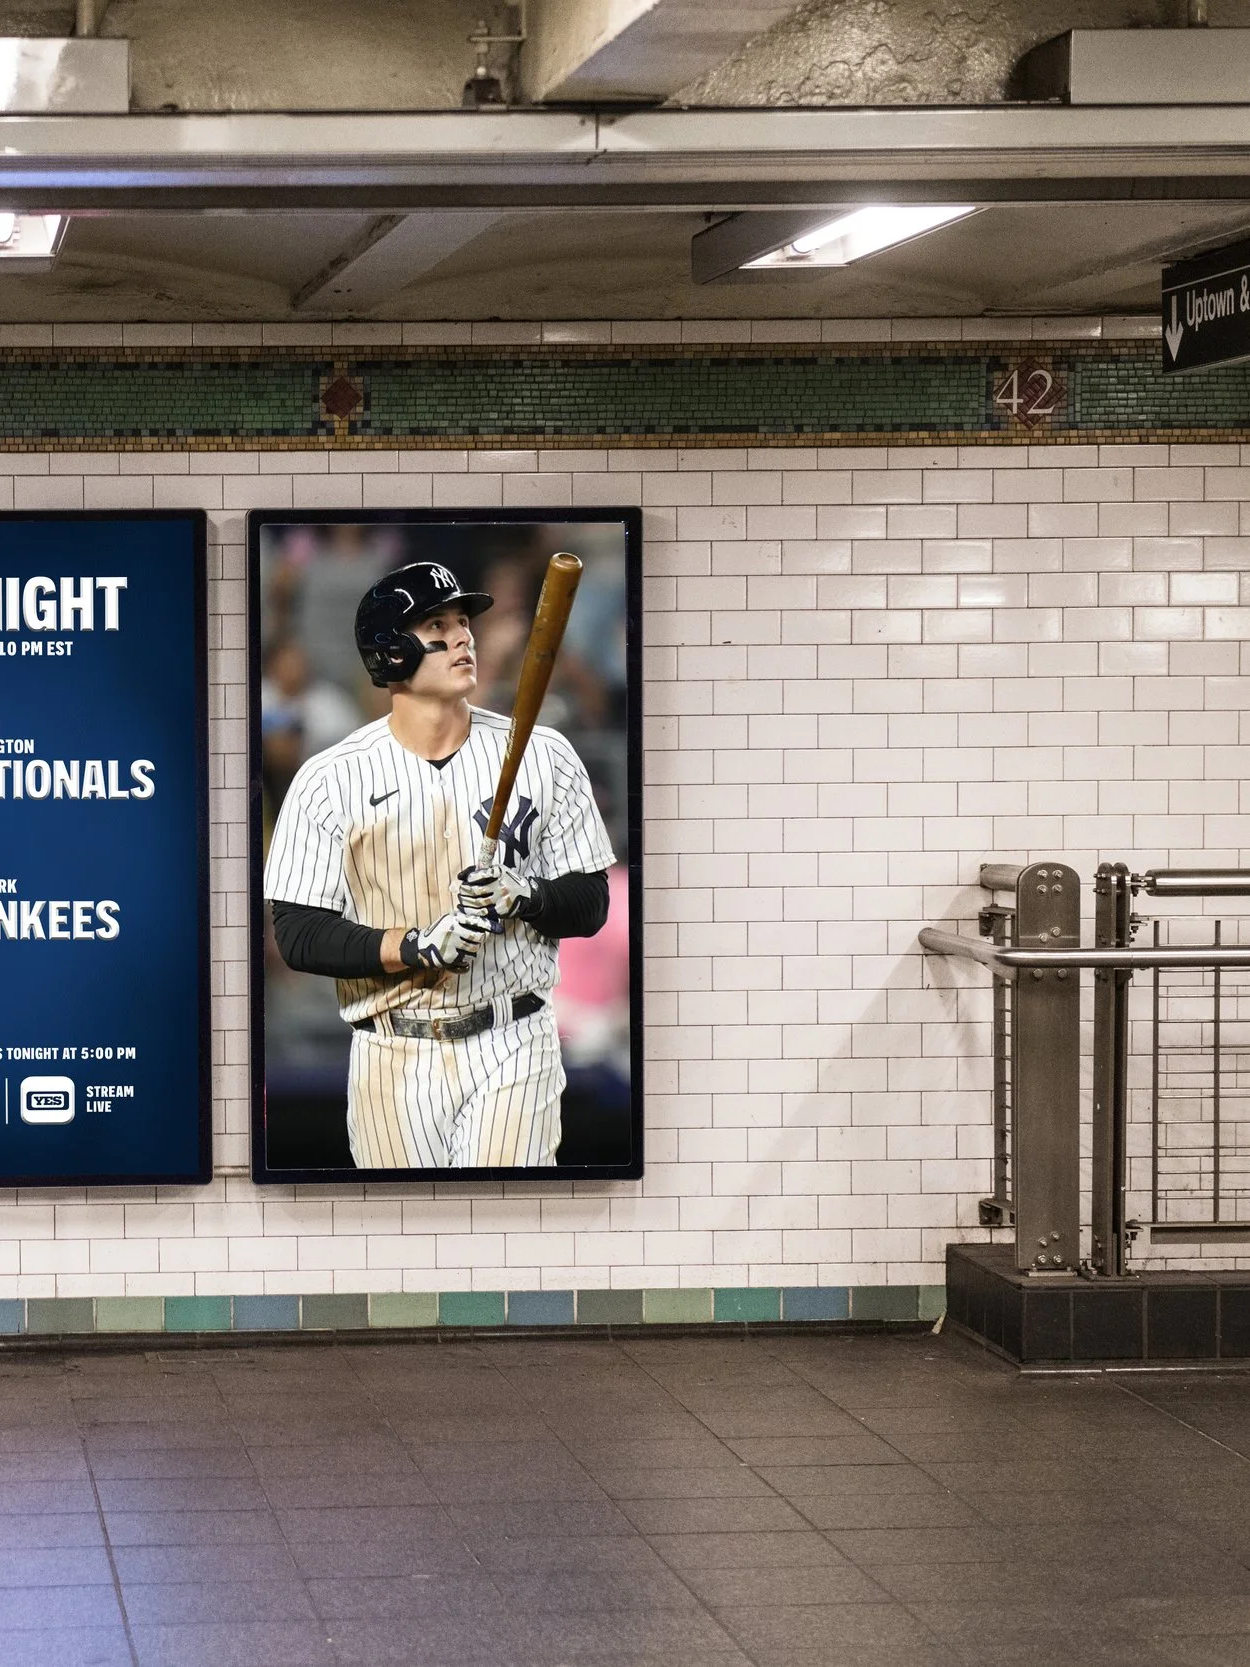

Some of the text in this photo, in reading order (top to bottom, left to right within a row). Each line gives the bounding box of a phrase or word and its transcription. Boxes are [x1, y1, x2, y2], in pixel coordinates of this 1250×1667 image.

[1186, 274, 1250, 331] Uptown &
[996, 369, 1055, 414] 42
[21, 641, 43, 656] PM
[47, 641, 73, 656] EST
[6, 1047, 59, 1060] TONIGHT
[62, 1047, 78, 1060] AT
[81, 1047, 113, 1060] 5:00
[116, 1047, 136, 1060] PM
[86, 1086, 135, 1098] STREAM
[33, 1095, 63, 1106] YES
[86, 1100, 112, 1113] LIVE
